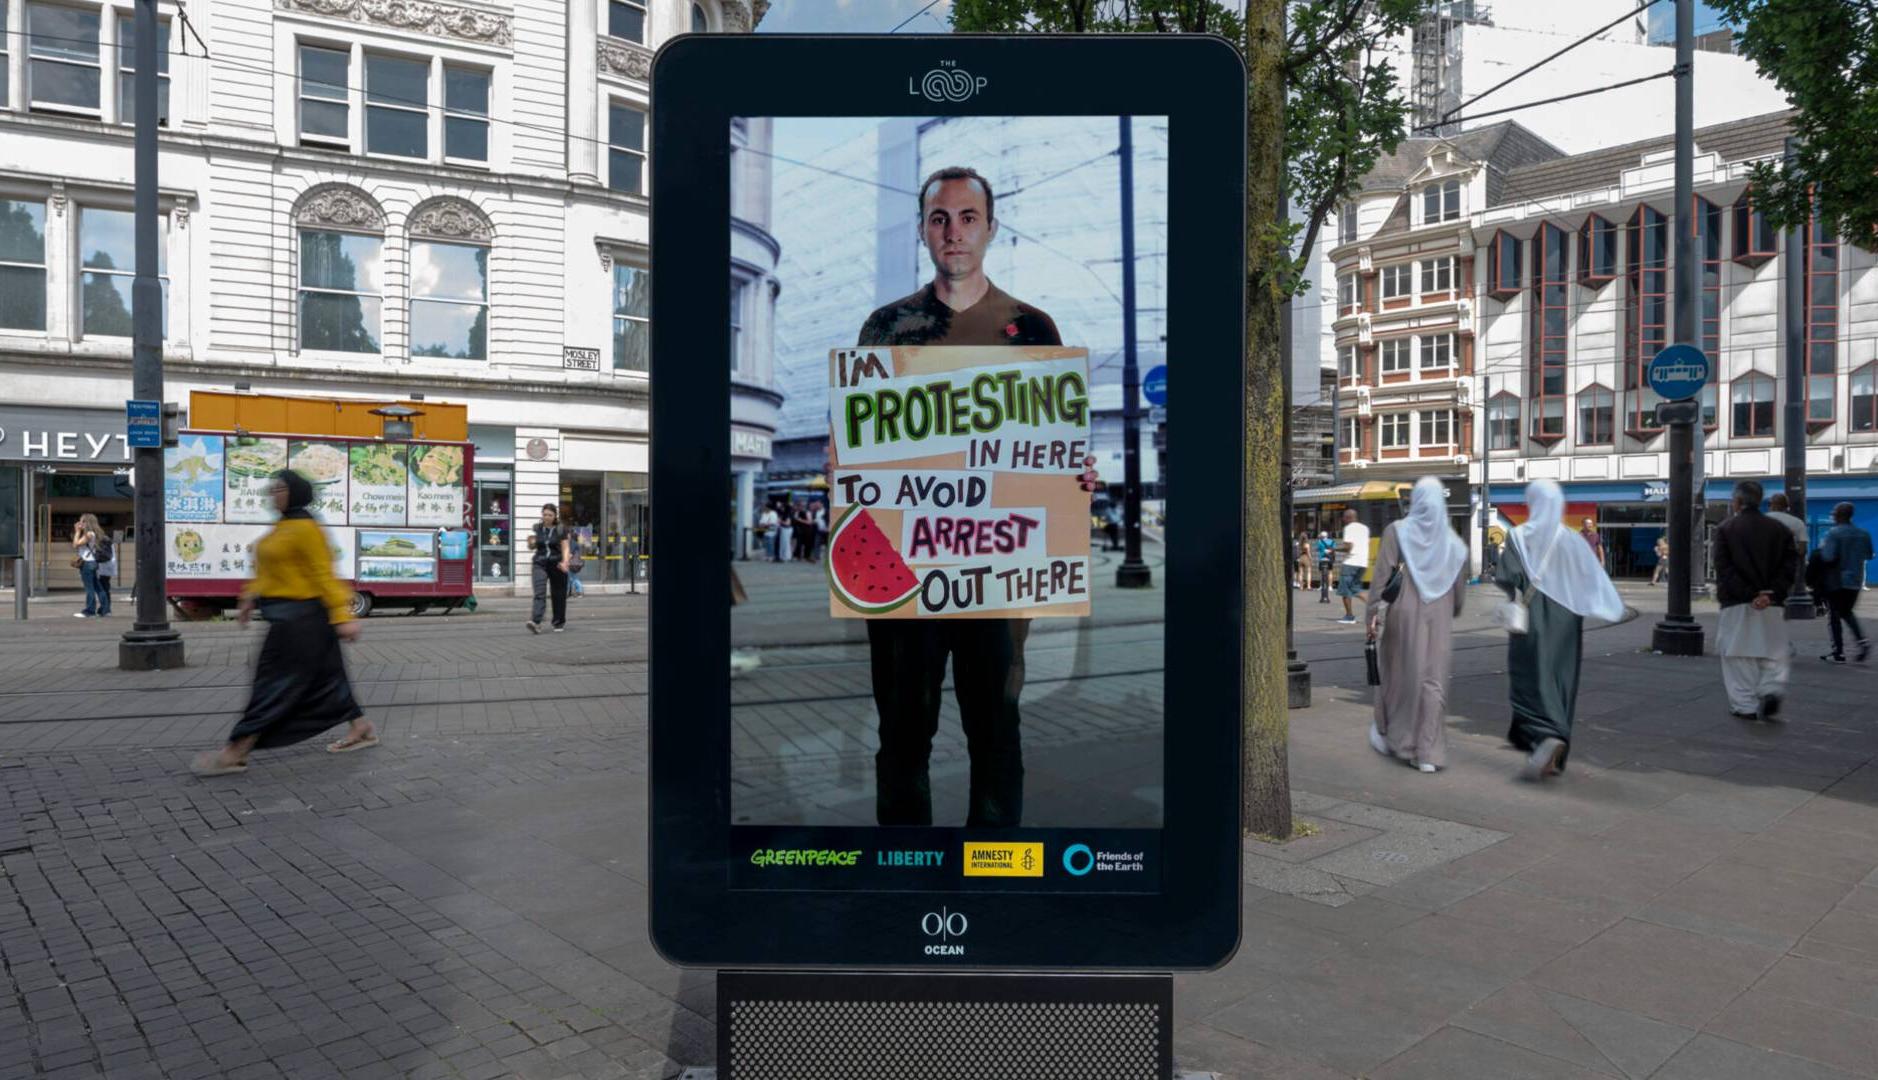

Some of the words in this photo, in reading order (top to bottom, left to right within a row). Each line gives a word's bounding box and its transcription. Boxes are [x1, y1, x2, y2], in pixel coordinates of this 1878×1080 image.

[565, 350, 598, 360] MOSLEY
[566, 359, 597, 368] STREET
[838, 350, 890, 388] I'M
[845, 369, 1090, 448] PROTESTING
[969, 439, 1002, 468] IN
[1011, 440, 1086, 469] HERE
[895, 474, 987, 508] AVOID
[909, 513, 1041, 558] ARREST
[921, 565, 993, 613] OUT
[996, 560, 1087, 603] THERE
[750, 849, 863, 868] GREENPEACE
[877, 851, 945, 866] LIBERTY
[971, 850, 1014, 861] AMNESTY
[1096, 852, 1132, 861] Friends
[1133, 851, 1144, 861] of
[1096, 862, 1114, 871] the
[1115, 862, 1143, 871] Earth
[924, 945, 964, 955] OCEAN
